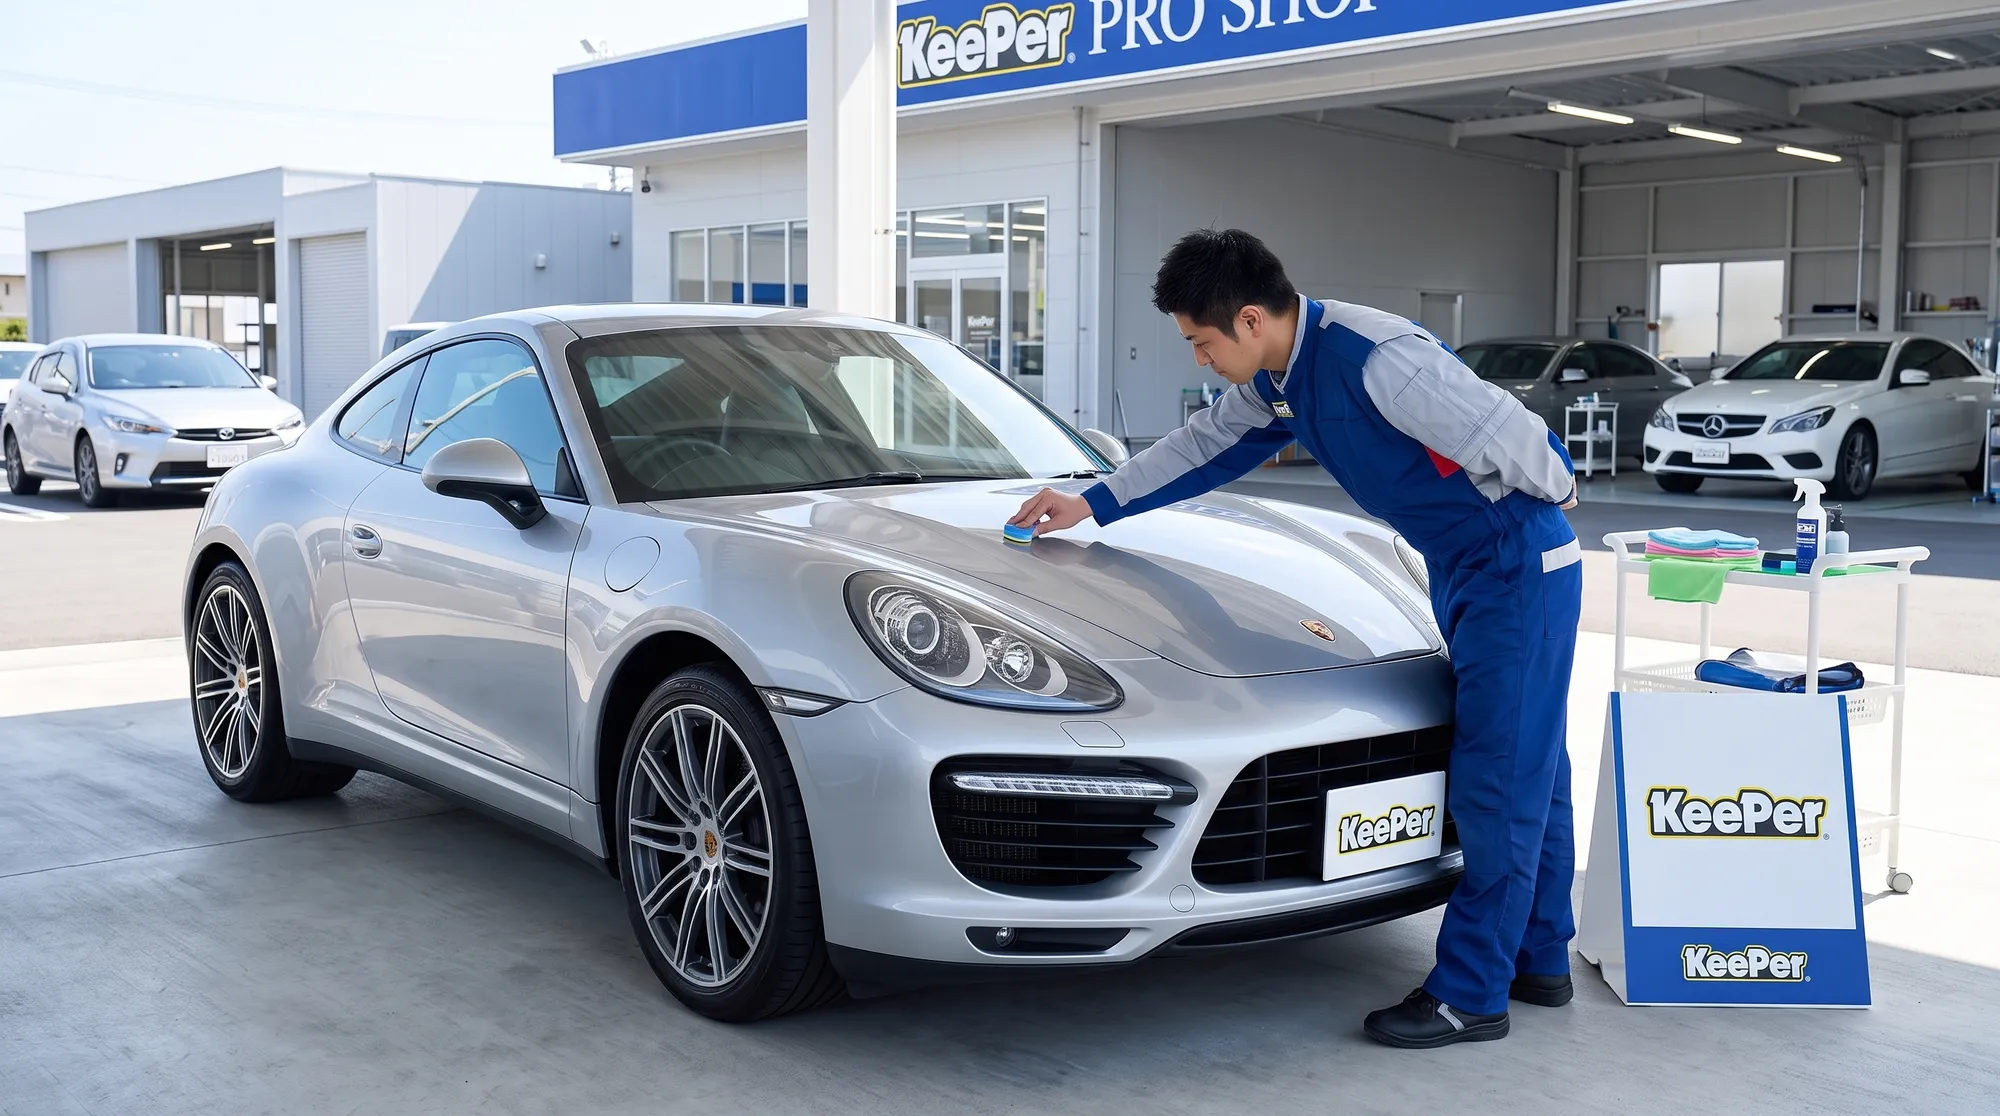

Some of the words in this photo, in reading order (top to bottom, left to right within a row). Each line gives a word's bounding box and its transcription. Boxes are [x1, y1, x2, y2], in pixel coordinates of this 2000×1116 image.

[898, 5, 1073, 83] KeePer
[1088, 0, 1204, 55] PRO
[1339, 806, 1435, 853] KeePer
[1648, 789, 1825, 836] KeePer
[1683, 946, 1805, 979] KeePer
